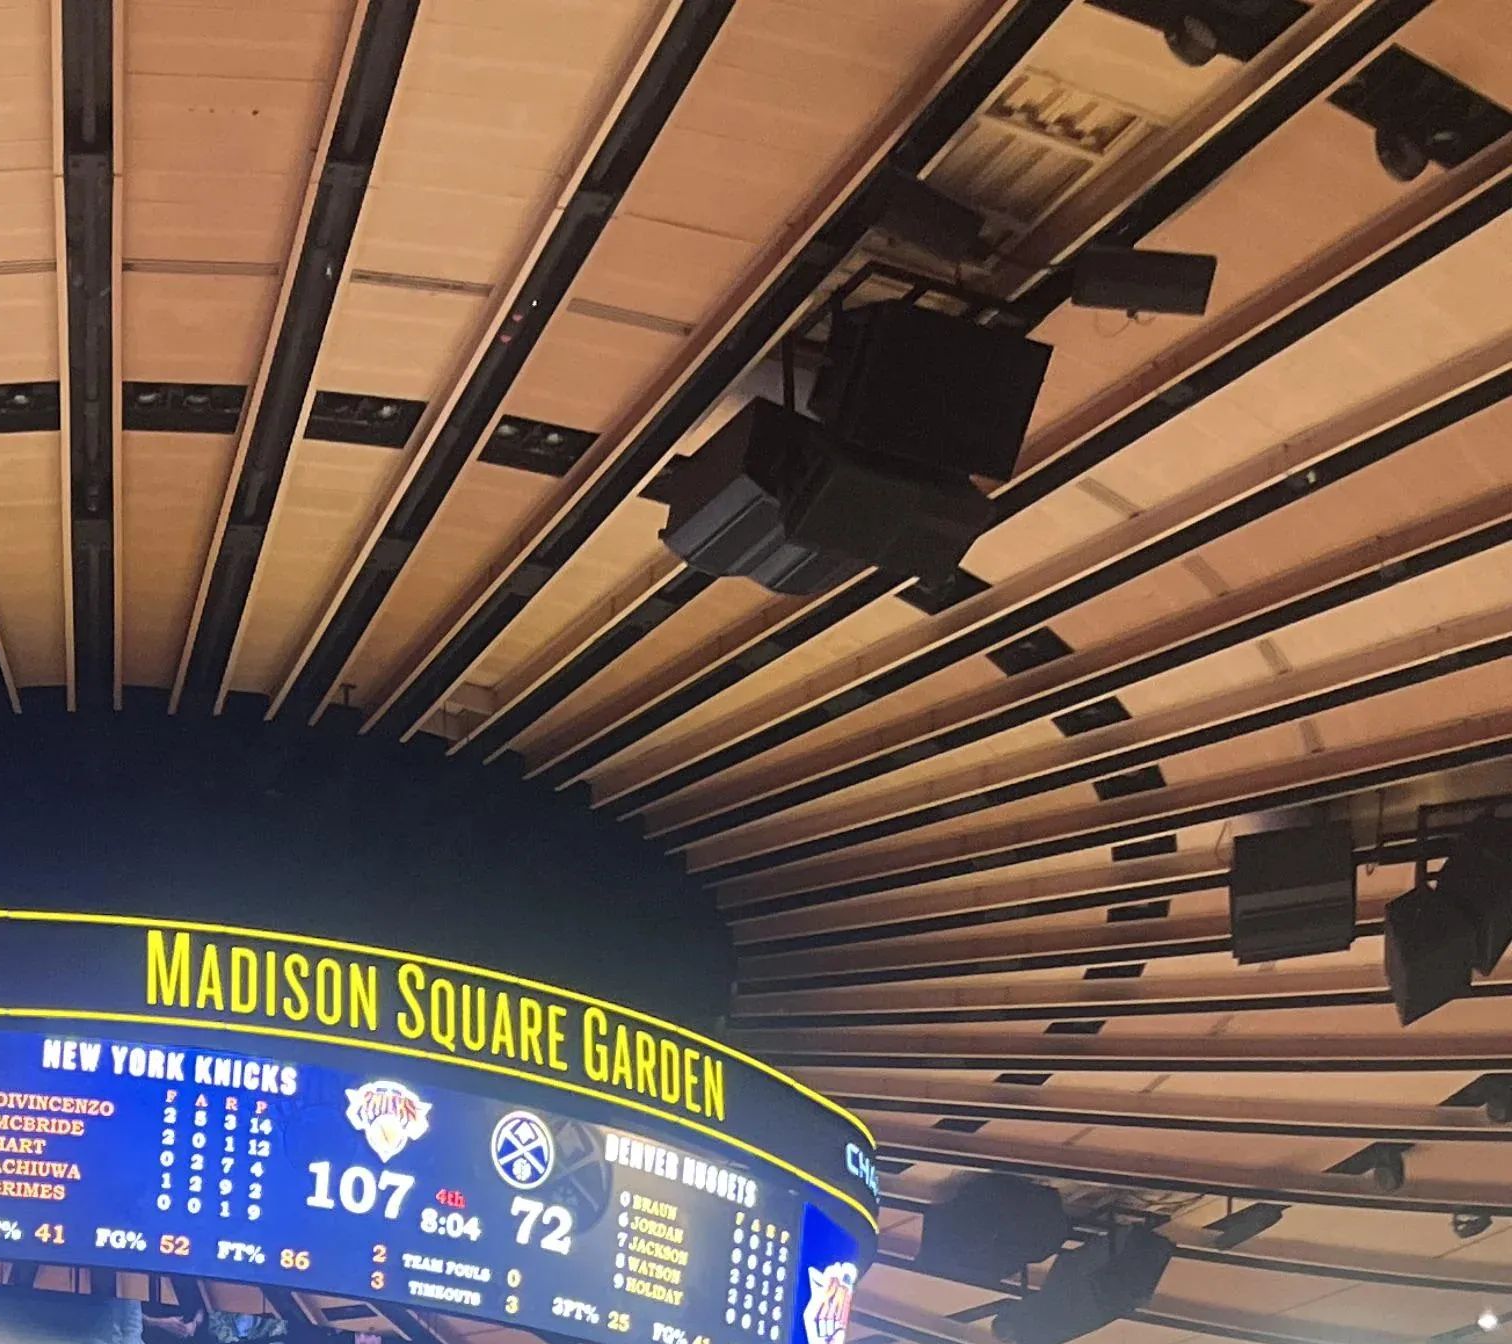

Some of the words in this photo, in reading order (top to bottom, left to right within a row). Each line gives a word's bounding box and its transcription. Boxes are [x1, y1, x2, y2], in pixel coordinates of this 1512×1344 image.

[146, 928, 378, 1031] MADISON
[397, 963, 568, 1071] SQUARE
[583, 1007, 726, 1121] GARDEN
[42, 1039, 101, 1072] NEW
[111, 1045, 185, 1082] YORK
[194, 1055, 297, 1095] KNICKS
[605, 1133, 679, 1180] DENVER
[683, 1156, 758, 1208] NUGGETS
[307, 1161, 415, 1219] 107
[436, 1189, 466, 1208] 4th
[620, 1191, 631, 1207] 0
[632, 1194, 678, 1221] BRAUN
[35, 1223, 65, 1244] 41
[420, 1208, 482, 1241] 8:04
[510, 1196, 573, 1255] 72
[618, 1211, 628, 1228] 6
[631, 1216, 684, 1244] JORDAN
[95, 1228, 147, 1251] FG%
[160, 1234, 190, 1256] 52
[217, 1240, 265, 1264] FT%
[280, 1249, 310, 1270] 86
[617, 1231, 627, 1247] 7
[628, 1236, 688, 1266] JACKSON
[373, 1245, 386, 1262] 2
[402, 1253, 444, 1275] TEAM
[507, 1269, 521, 1287] 0
[615, 1252, 625, 1269] 8
[628, 1255, 681, 1285] WATSON
[371, 1272, 384, 1289] 3
[409, 1281, 481, 1306] TIMEOUTS
[505, 1296, 519, 1313] 3
[613, 1273, 624, 1289] 9
[625, 1276, 684, 1306] HOLIDAY
[607, 1310, 631, 1332] 25
